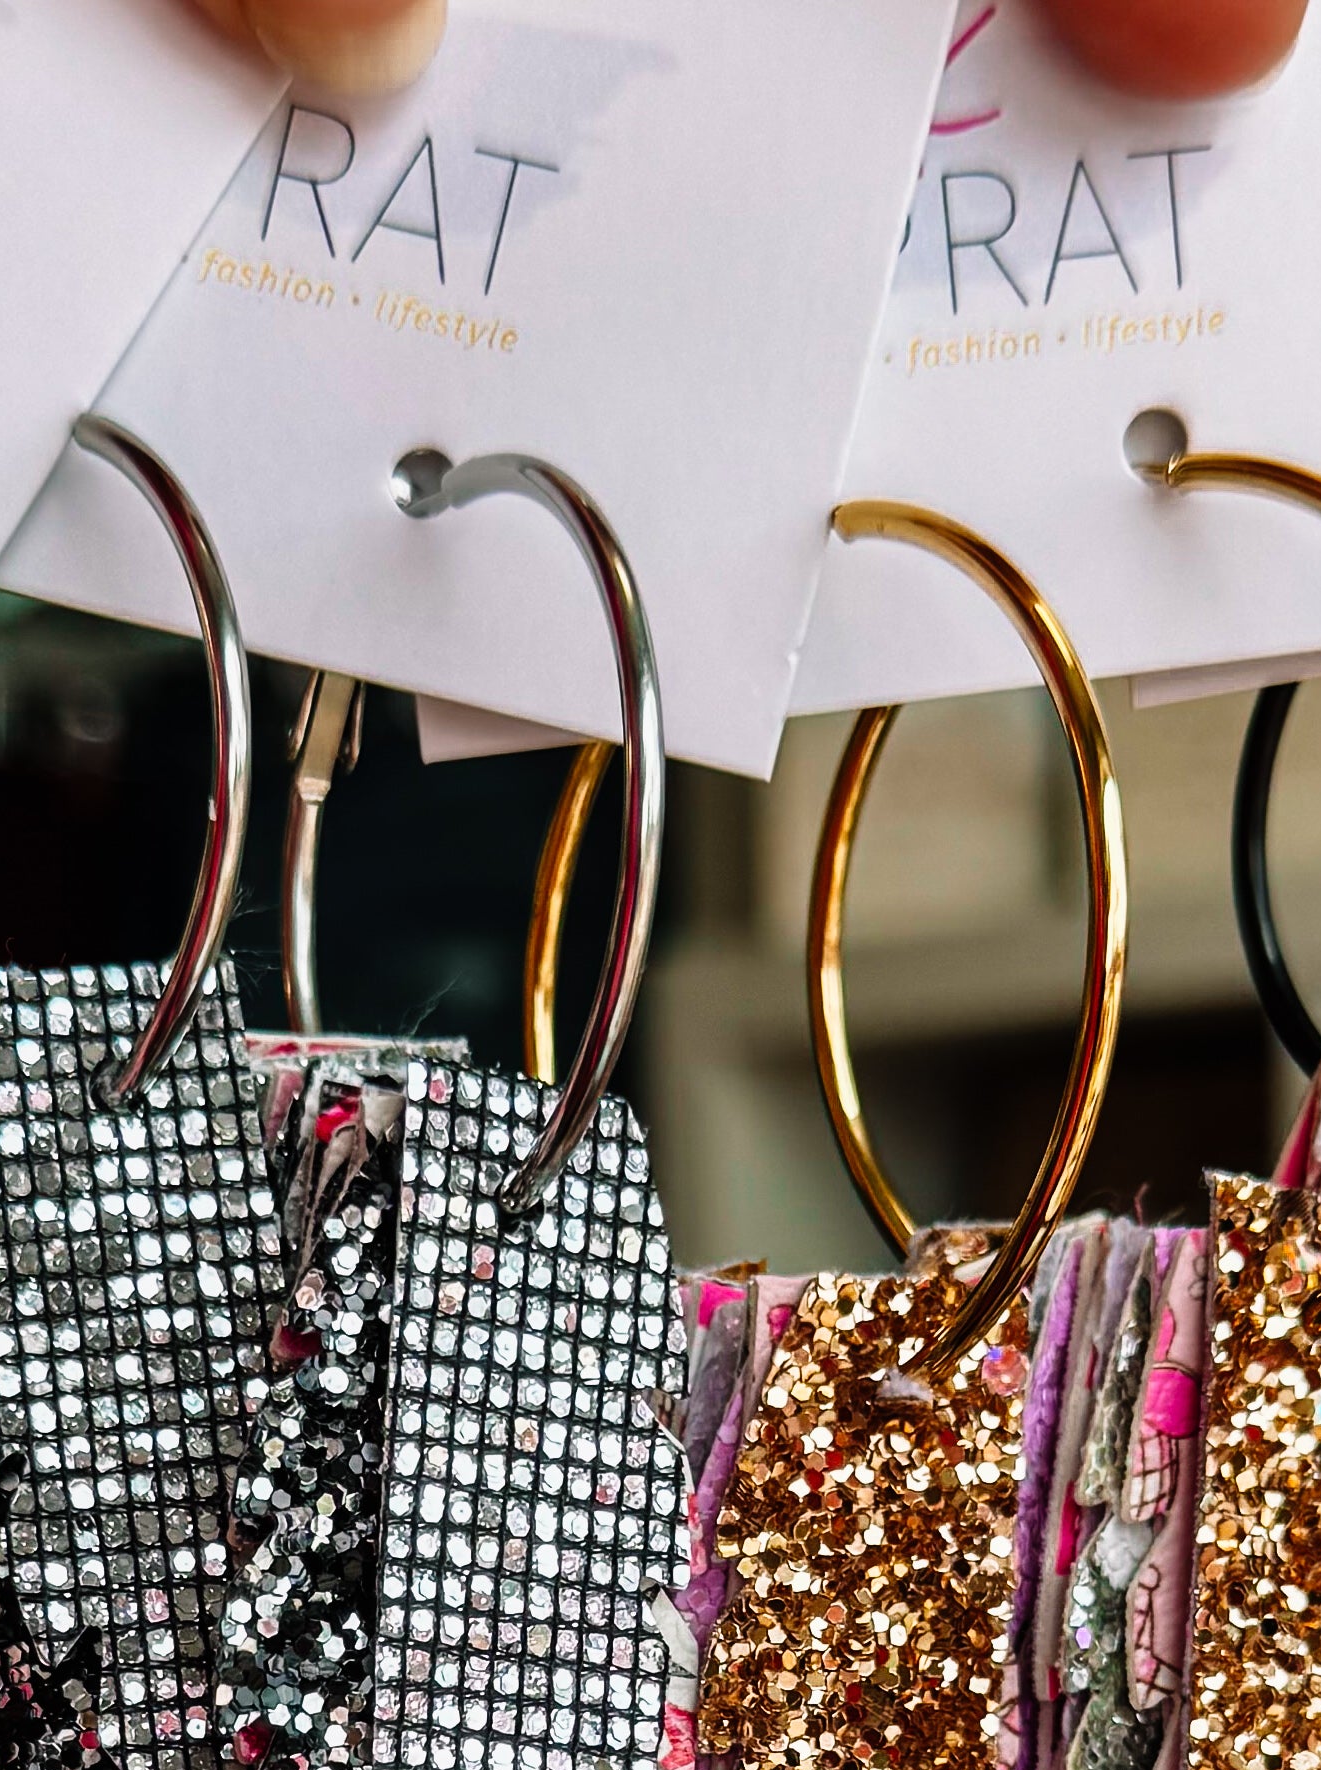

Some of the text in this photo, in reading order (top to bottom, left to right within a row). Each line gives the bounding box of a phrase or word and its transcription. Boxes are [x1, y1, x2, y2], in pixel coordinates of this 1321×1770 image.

[198, 247, 519, 354] fashion lifestyle
[906, 307, 1227, 376] fashion lifestyle
